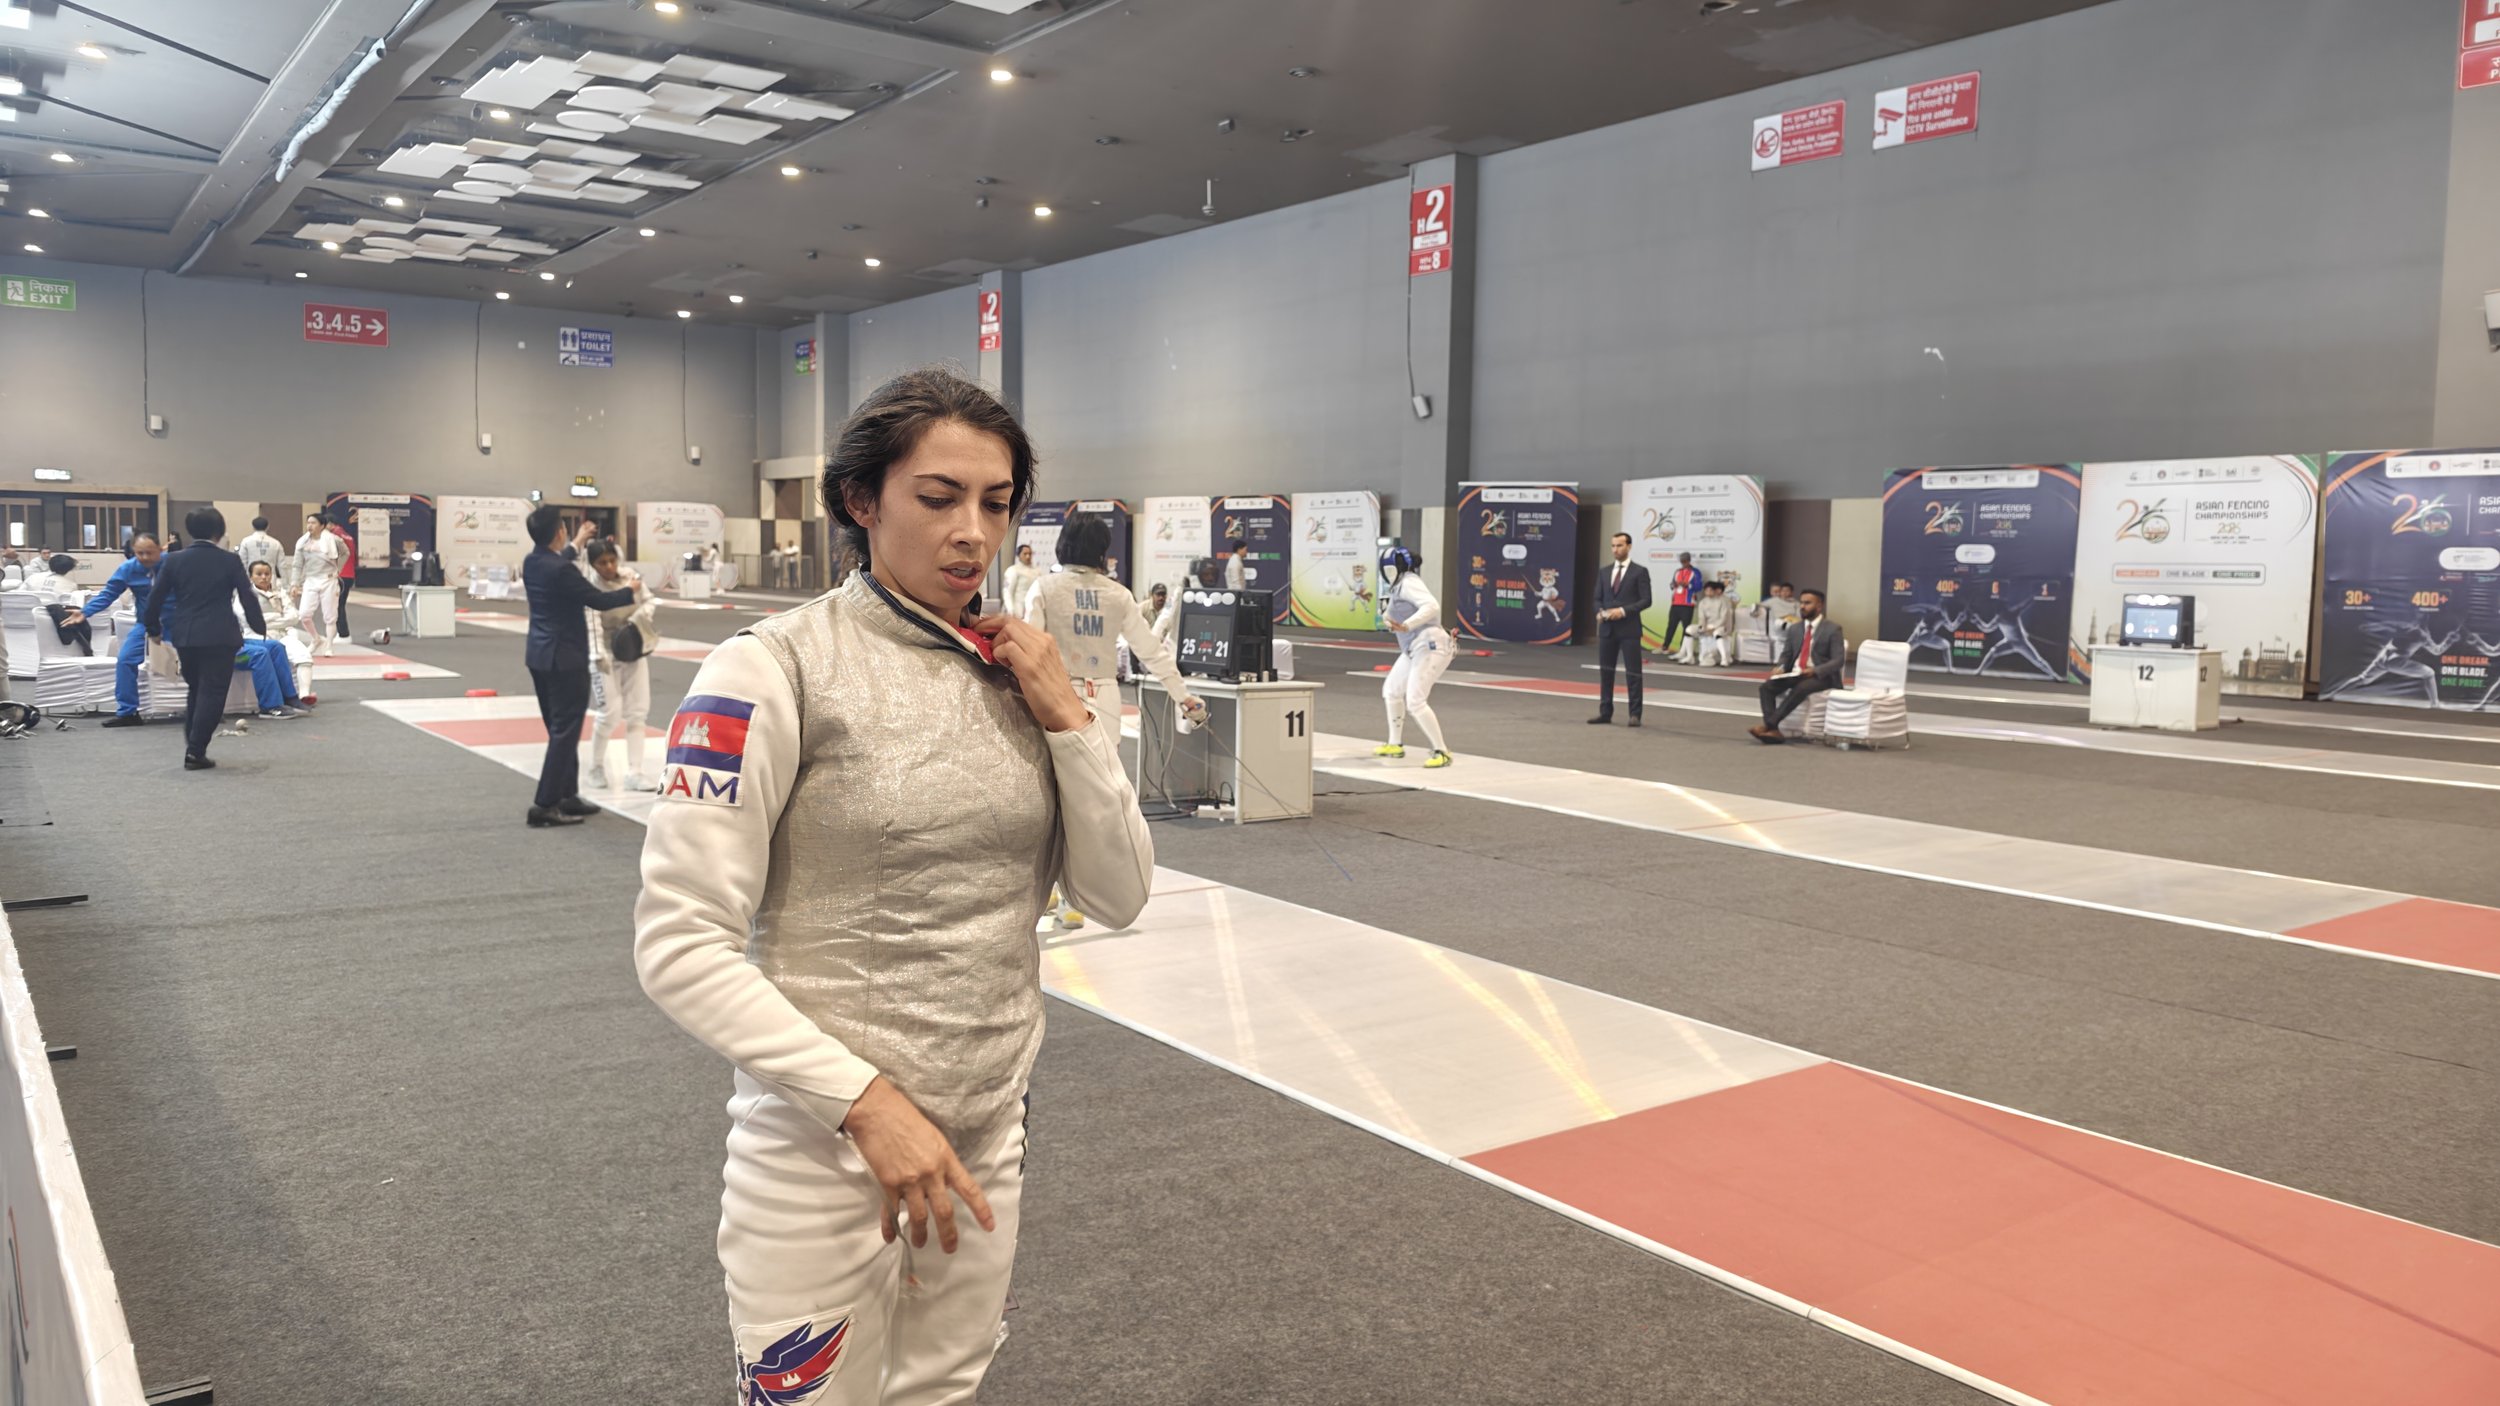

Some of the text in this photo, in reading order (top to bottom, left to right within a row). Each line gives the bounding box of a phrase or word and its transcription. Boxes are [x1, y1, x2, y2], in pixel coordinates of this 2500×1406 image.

[1921, 112, 1932, 121] are
[1934, 108, 1953, 118] under
[1906, 116, 1968, 136] CCTV Surveillance
[1432, 250, 1440, 269] 8
[29, 279, 69, 295] निकास
[30, 293, 63, 305] EXIT
[580, 341, 611, 352] TOILET
[2196, 499, 2270, 511] ASIAN FENCING
[2195, 510, 2269, 520] CHAMPIONSHIPS
[2182, 570, 2205, 578] BLADE
[1893, 578, 1911, 591] 30+
[1936, 580, 1960, 593] 400+
[1496, 589, 1506, 598] ONE
[2345, 590, 2372, 605] 30+
[2411, 592, 2449, 607] 400+
[1074, 613, 1103, 637] CAM
[1182, 638, 1196, 655] 25
[1215, 640, 1229, 658] 21
[1954, 640, 1965, 648] ONE
[2441, 655, 2457, 664] ONE
[2138, 664, 2154, 681] 12
[2200, 666, 2208, 682] 12
[2441, 666, 2488, 677] ONE BLADE.
[2441, 677, 2457, 686] ONE
[1285, 710, 1304, 737] 11
